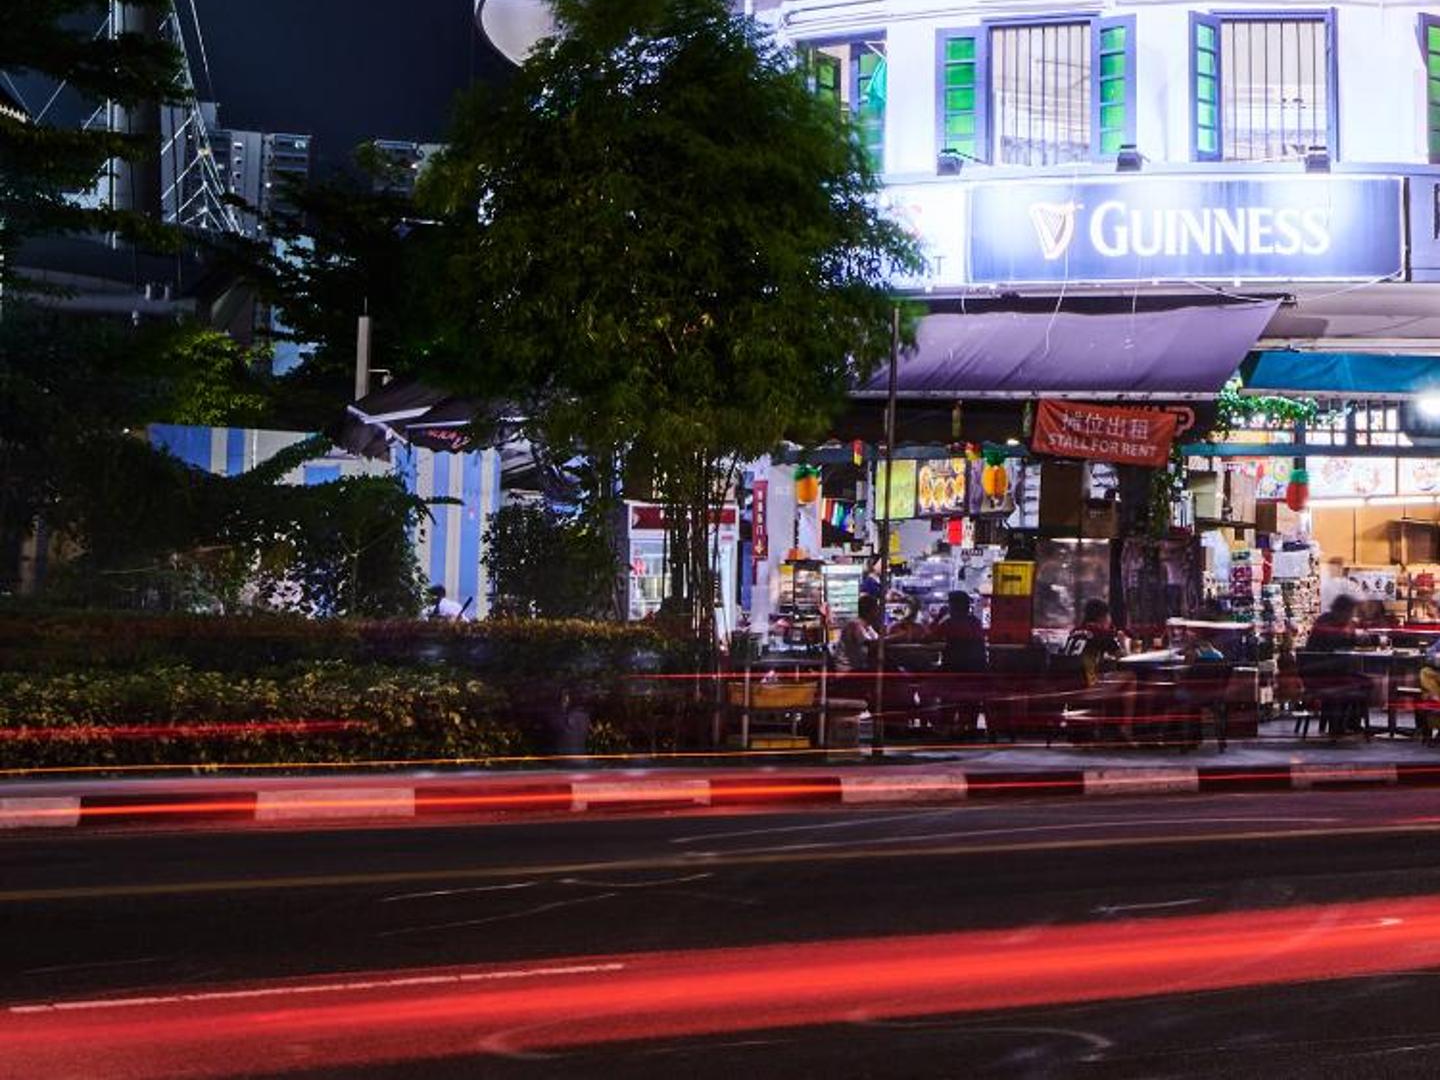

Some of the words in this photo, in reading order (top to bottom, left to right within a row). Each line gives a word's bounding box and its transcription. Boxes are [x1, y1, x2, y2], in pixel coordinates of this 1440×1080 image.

[1090, 201, 1332, 256] GUINNESS
[1049, 432, 1089, 451] STALL
[1091, 437, 1121, 455] FOR
[1121, 442, 1157, 457] RENT
